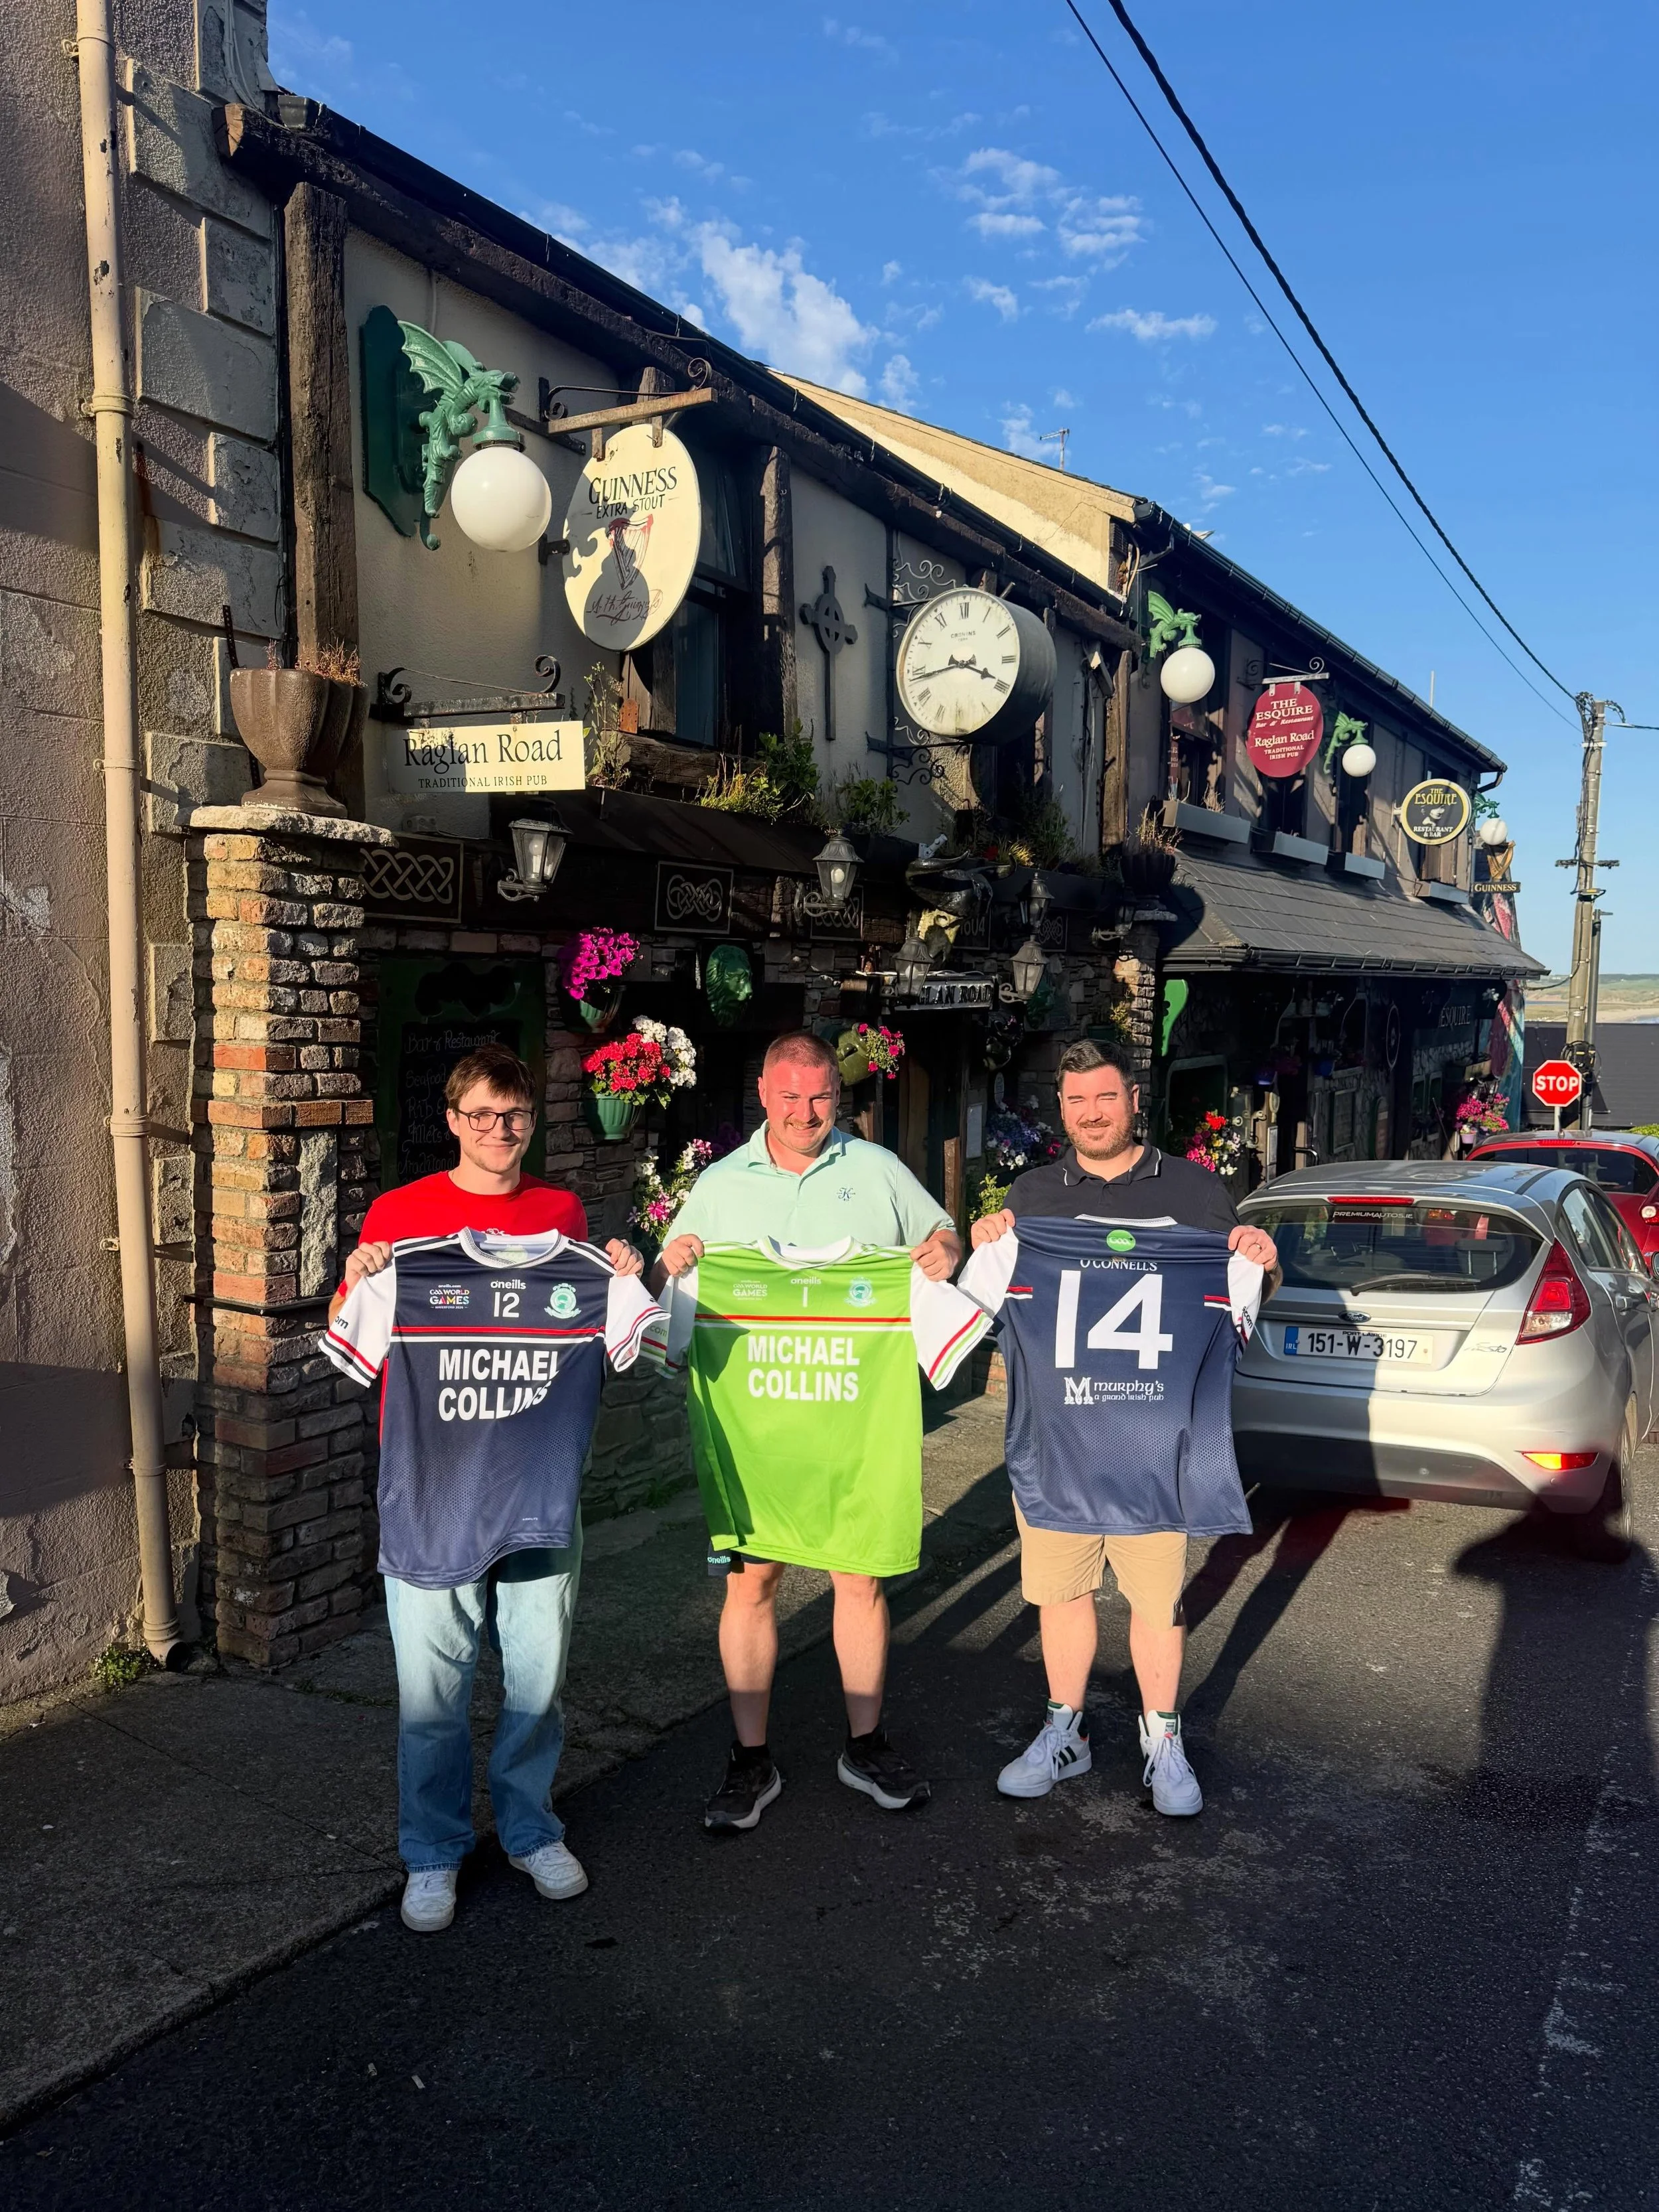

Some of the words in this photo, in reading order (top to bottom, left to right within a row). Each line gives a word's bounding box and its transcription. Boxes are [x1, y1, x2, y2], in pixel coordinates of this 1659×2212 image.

[589, 467, 677, 504] GUINNESS
[597, 502, 627, 519] EXTRA
[633, 494, 665, 512] STOUT
[1256, 705, 1313, 721] ESQUIRE
[1271, 698, 1297, 709] THE
[1280, 716, 1313, 725] Restaurant
[1254, 735, 1287, 748] Raglan
[1289, 730, 1315, 742] Road
[403, 734, 488, 774] Raglan
[497, 729, 563, 763] Road
[1264, 745, 1305, 755] TRADITIONAL
[418, 777, 490, 788] TRADITIONAL
[494, 776, 522, 786] IRISH
[527, 775, 547, 786] PUB
[1414, 793, 1457, 806] ESQUIRE
[1474, 883, 1517, 892] GUINNESS
[958, 985, 993, 1003] ROAD
[1439, 1005, 1471, 1031] ESQUIRE
[404, 1033, 433, 1054] Bar
[444, 1030, 502, 1049] Restaurant
[1536, 1075, 1579, 1091] STOP
[429, 1295, 470, 1305] GAMES
[494, 1291, 520, 1317] 12
[1055, 1270, 1173, 1369] 14
[748, 1335, 860, 1366] MICHAEL
[1308, 1333, 1417, 1359] 151-W-3197
[439, 1349, 560, 1381] MICHAEL
[748, 1368, 859, 1402] COLLINS
[438, 1380, 552, 1422] COLLINS
[1102, 1393, 1126, 1402] grand
[1149, 1394, 1164, 1402] pub
